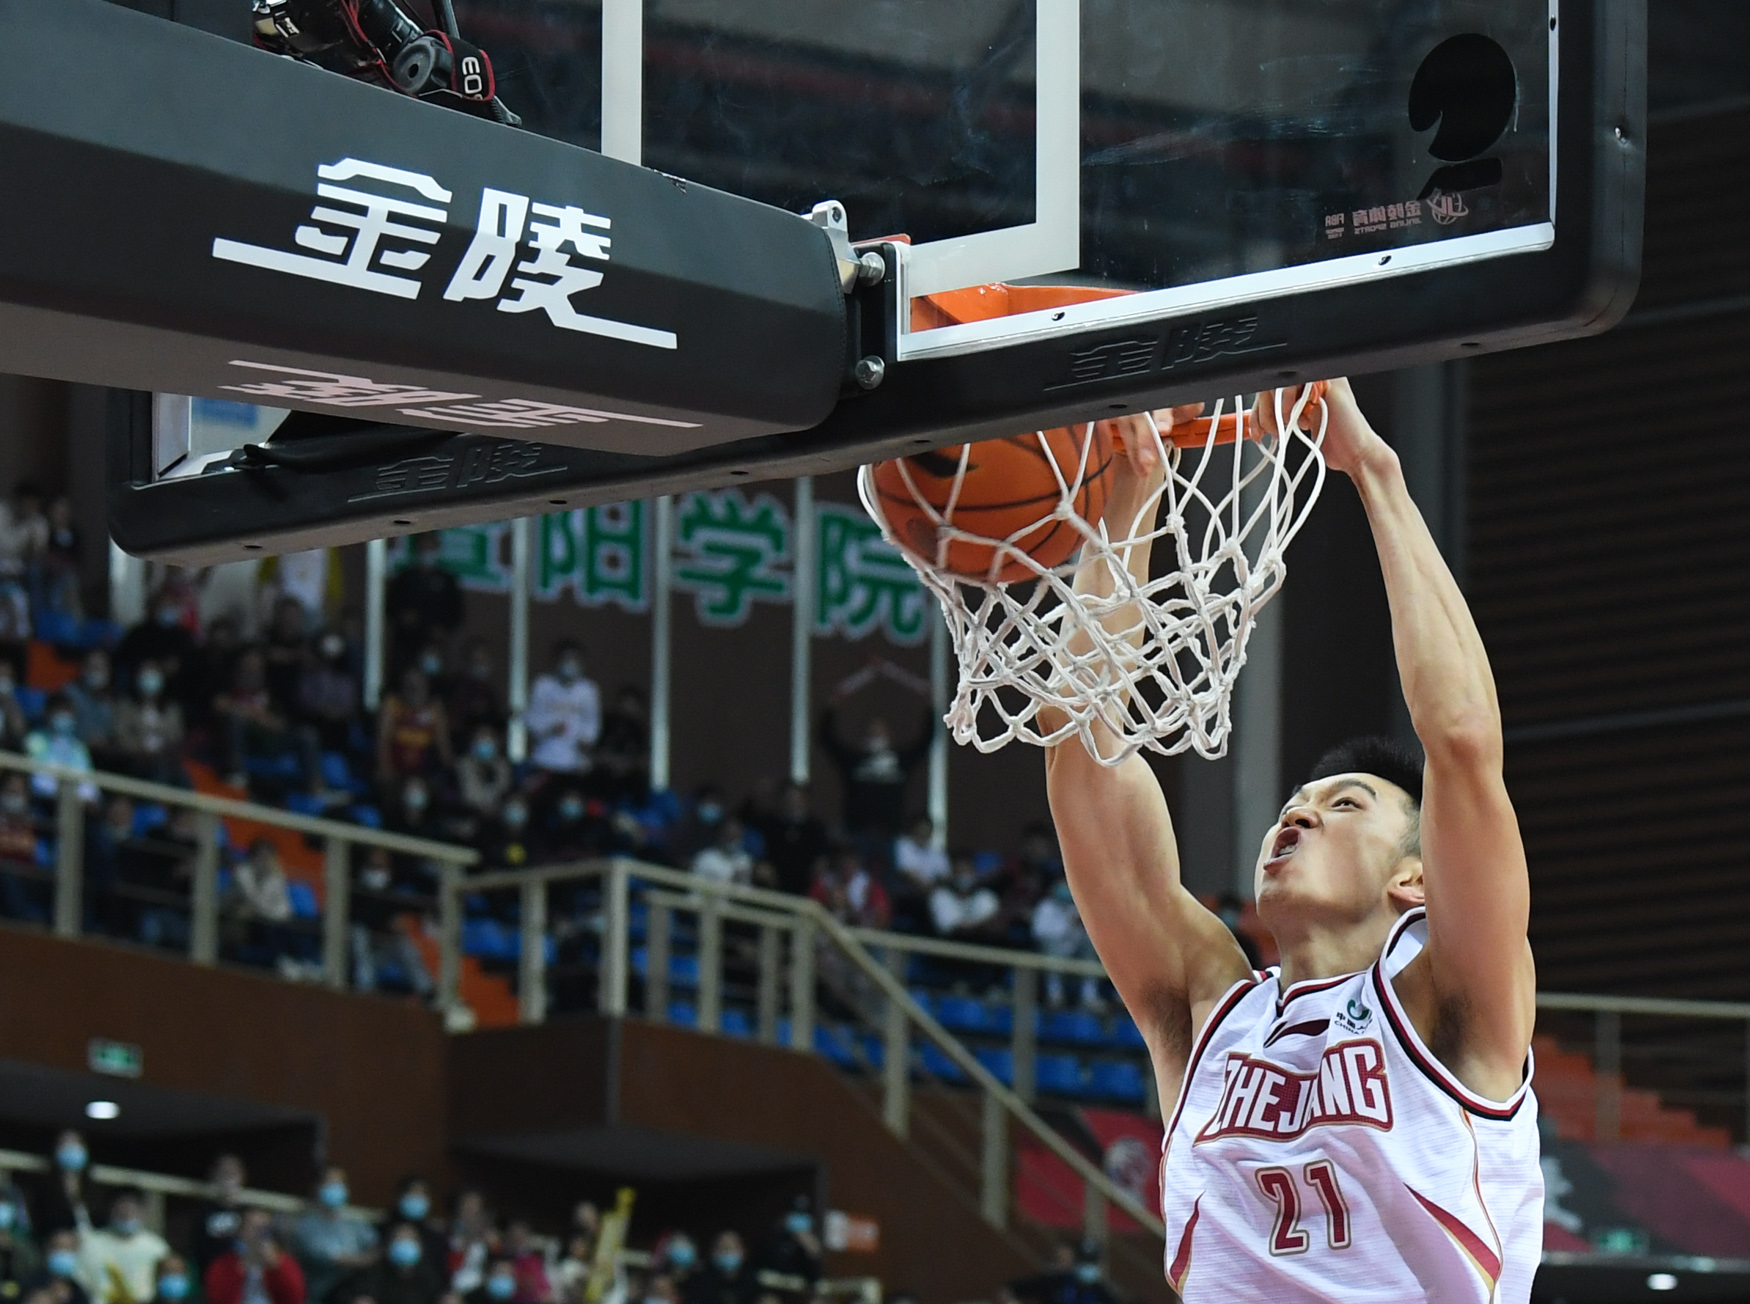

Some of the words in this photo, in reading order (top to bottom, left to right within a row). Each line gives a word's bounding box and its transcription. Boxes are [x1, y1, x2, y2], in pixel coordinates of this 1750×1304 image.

[211, 156, 678, 350] 金陵
[1202, 1044, 1389, 1136] ZHEJANG
[1255, 1158, 1351, 1257] 21
